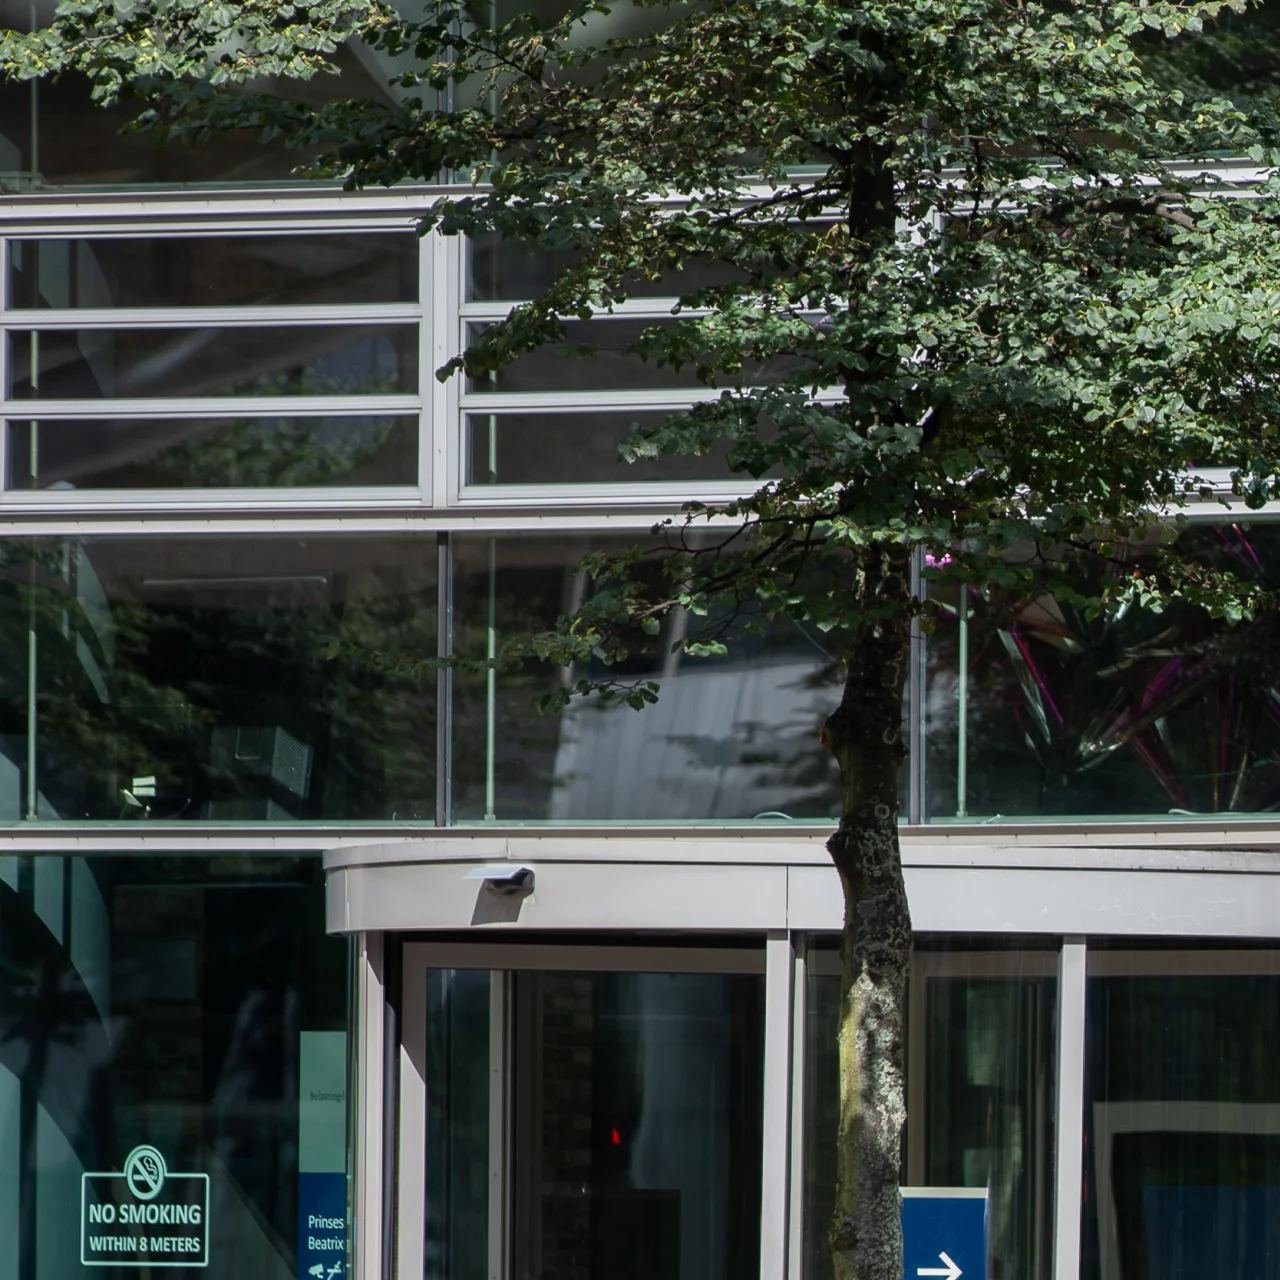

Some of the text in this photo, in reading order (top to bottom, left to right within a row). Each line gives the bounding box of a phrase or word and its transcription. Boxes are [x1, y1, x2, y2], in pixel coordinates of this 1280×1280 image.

[89, 1204, 201, 1224] NO SMOKING
[308, 1215, 344, 1229] Prinses
[89, 1236, 200, 1252] WITHIN 8 METERS
